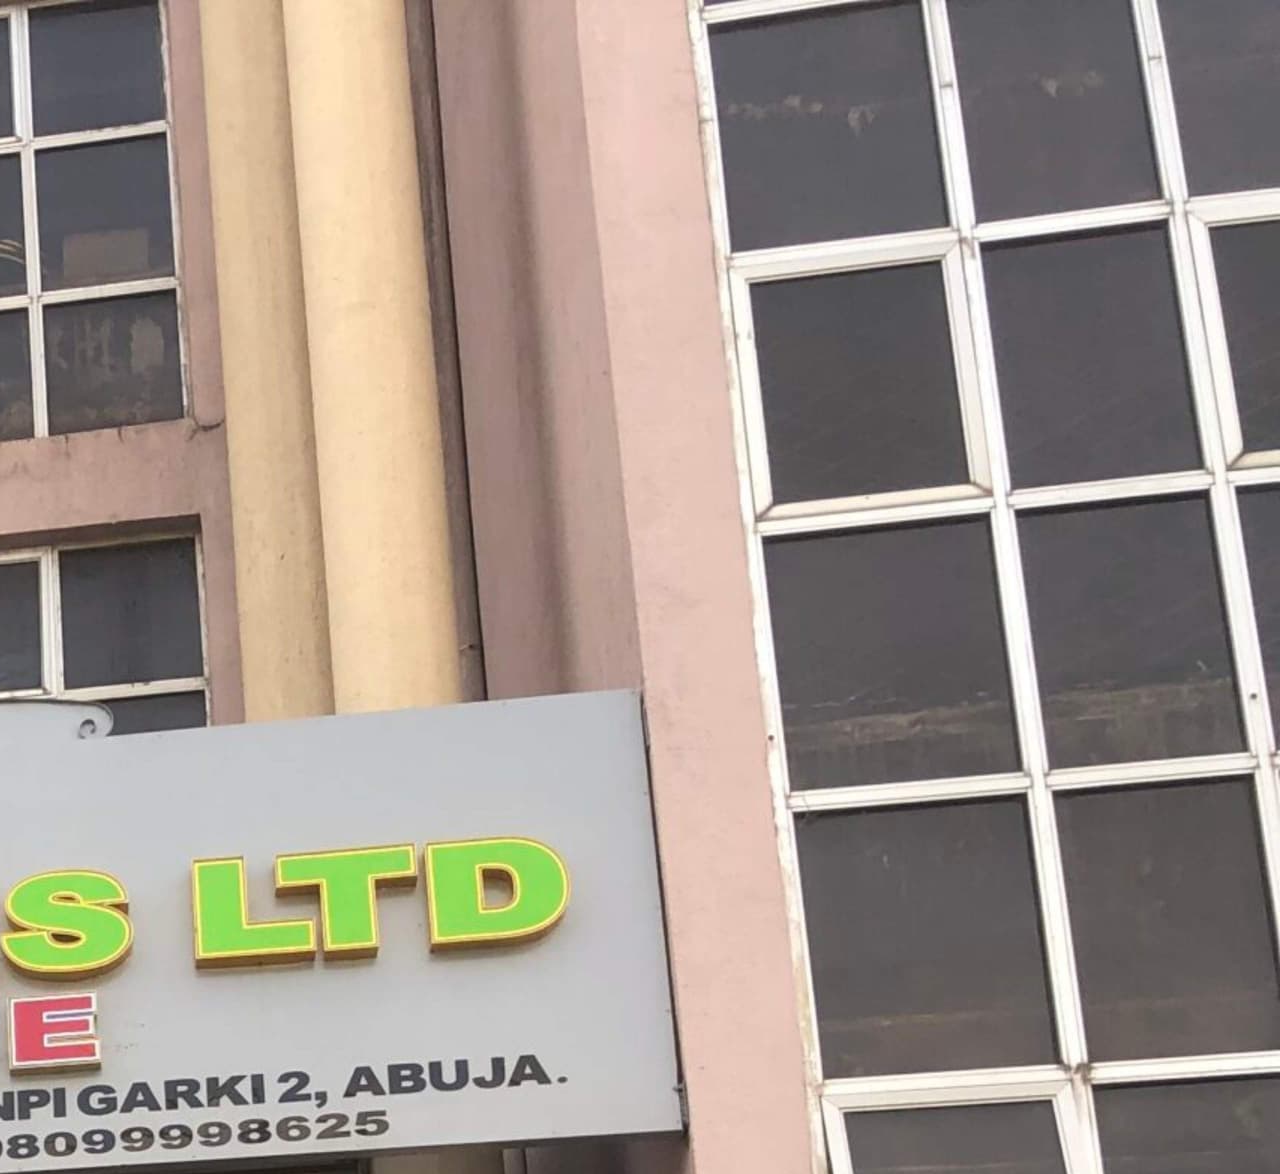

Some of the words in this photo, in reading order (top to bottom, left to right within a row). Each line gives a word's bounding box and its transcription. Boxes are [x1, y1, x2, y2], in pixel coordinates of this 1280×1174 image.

[191, 836, 570, 967] LTD
[76, 1074, 266, 1116] GARKI
[277, 1071, 328, 1109] 2,
[343, 1054, 568, 1099] ABUJA.
